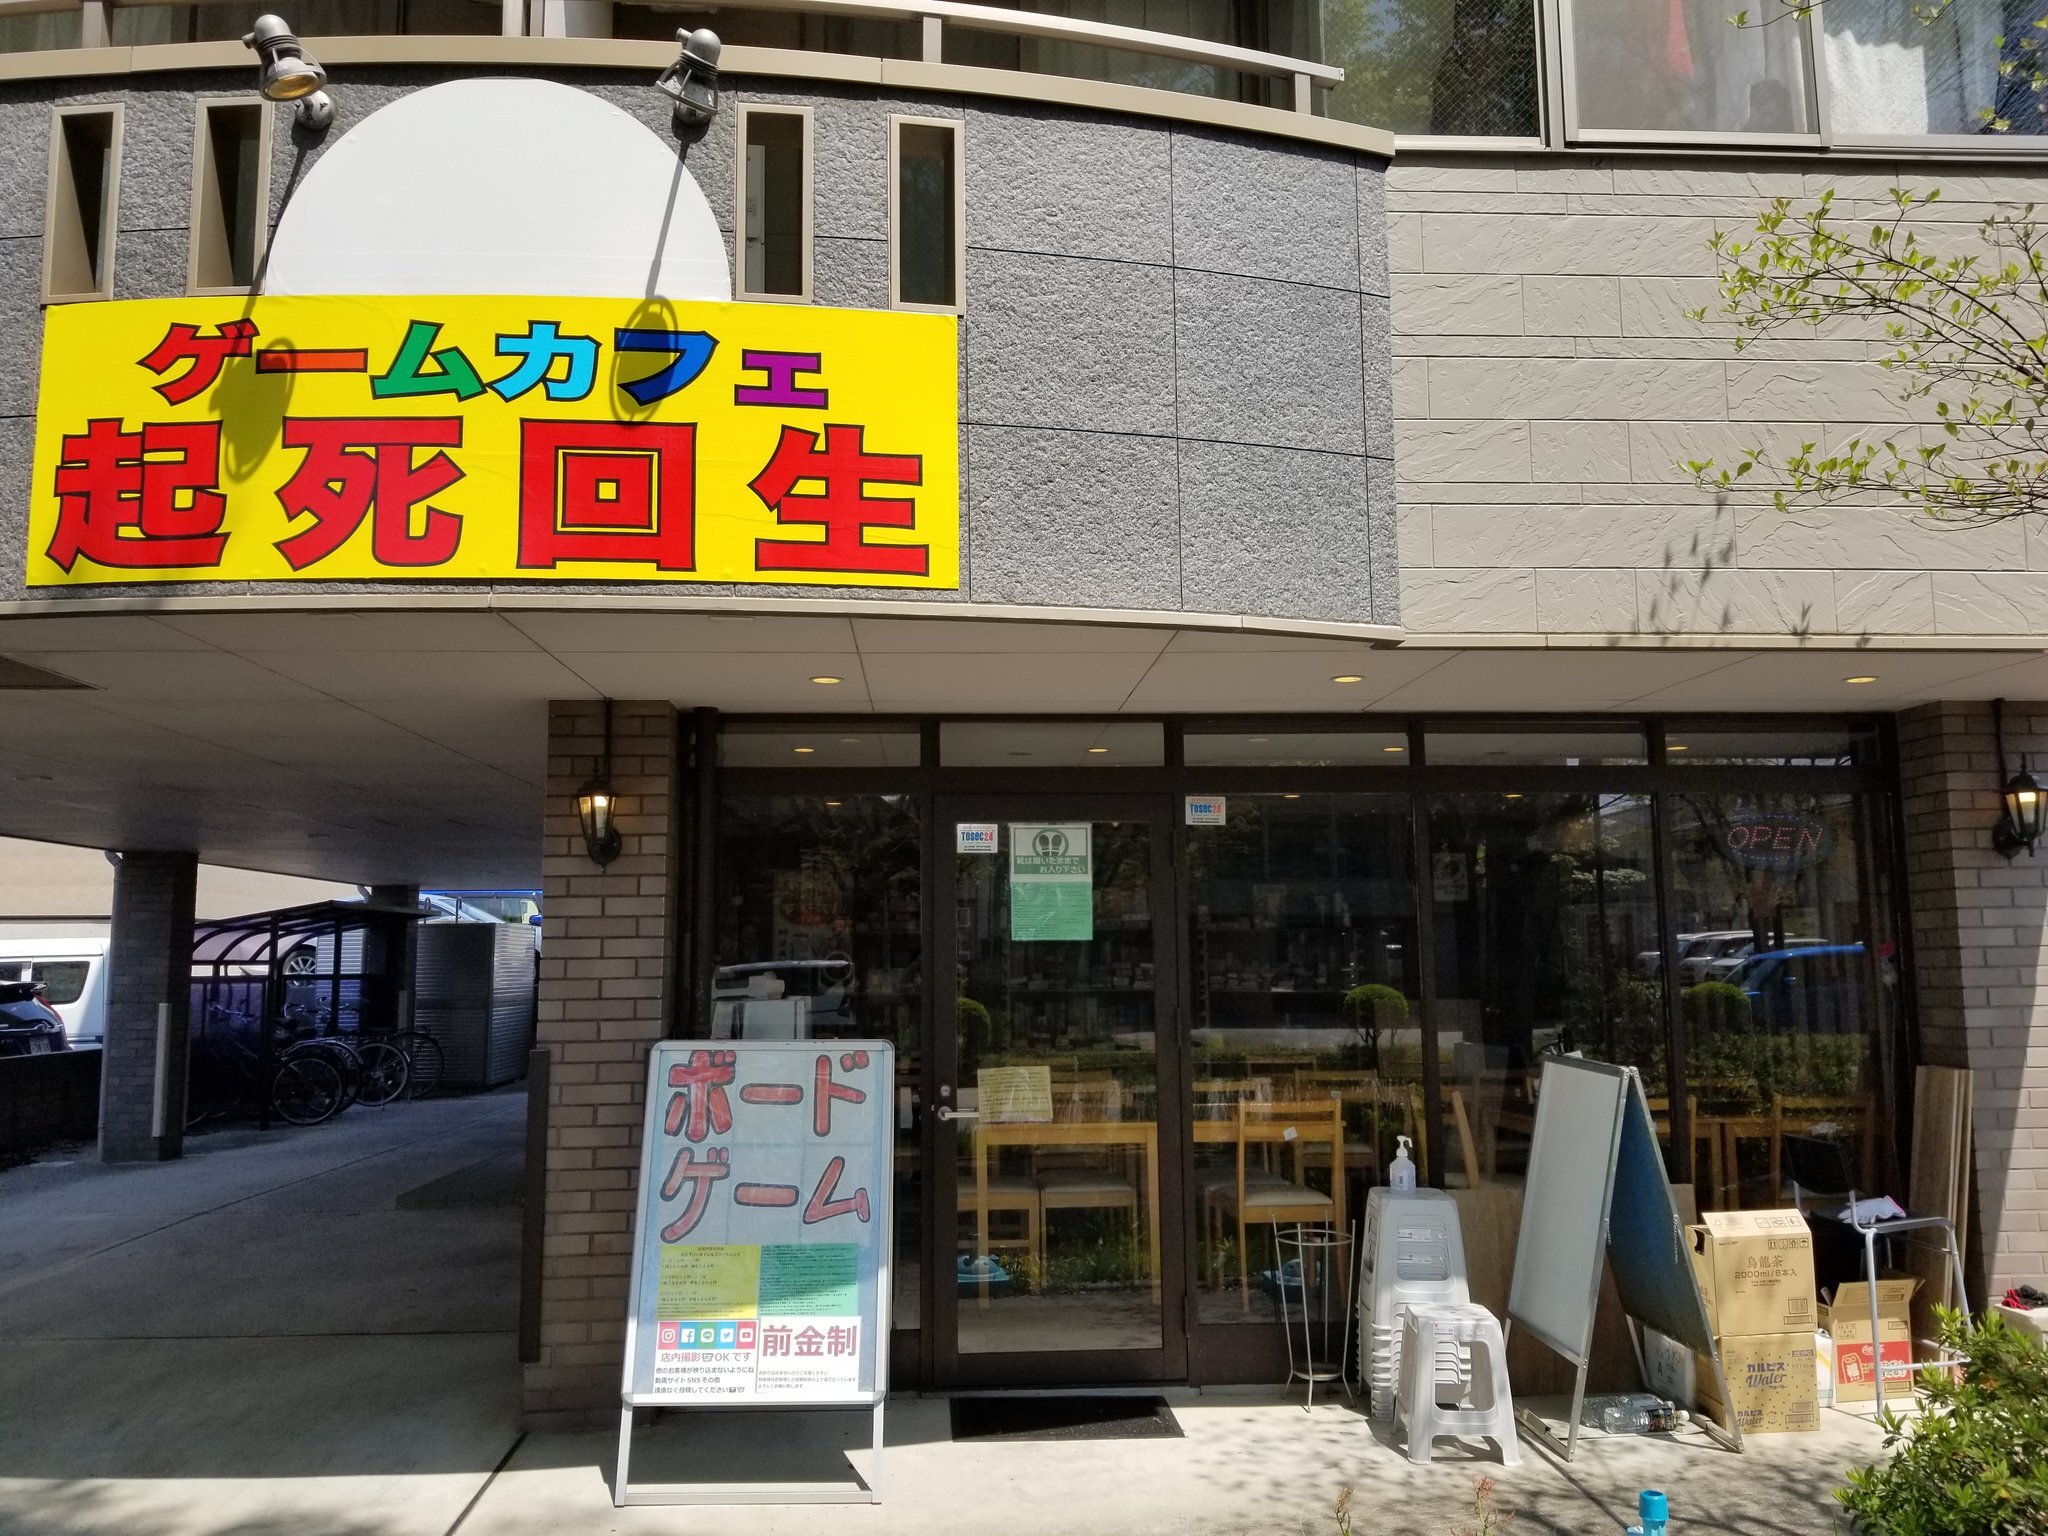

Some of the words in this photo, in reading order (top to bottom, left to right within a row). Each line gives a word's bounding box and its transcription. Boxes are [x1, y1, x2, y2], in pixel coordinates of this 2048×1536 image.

[137, 320, 830, 408] ゲームカフェ
[45, 415, 931, 577] 起死回生
[1727, 826, 1824, 850] OPEN
[1039, 865, 1086, 874] お入り下さい
[664, 1049, 870, 1144] ボード
[660, 1146, 871, 1244] ゲーム
[762, 1324, 858, 1358] 前金制
[1746, 1362, 1786, 1373] カルピス
[1746, 1373, 1788, 1388] Water
